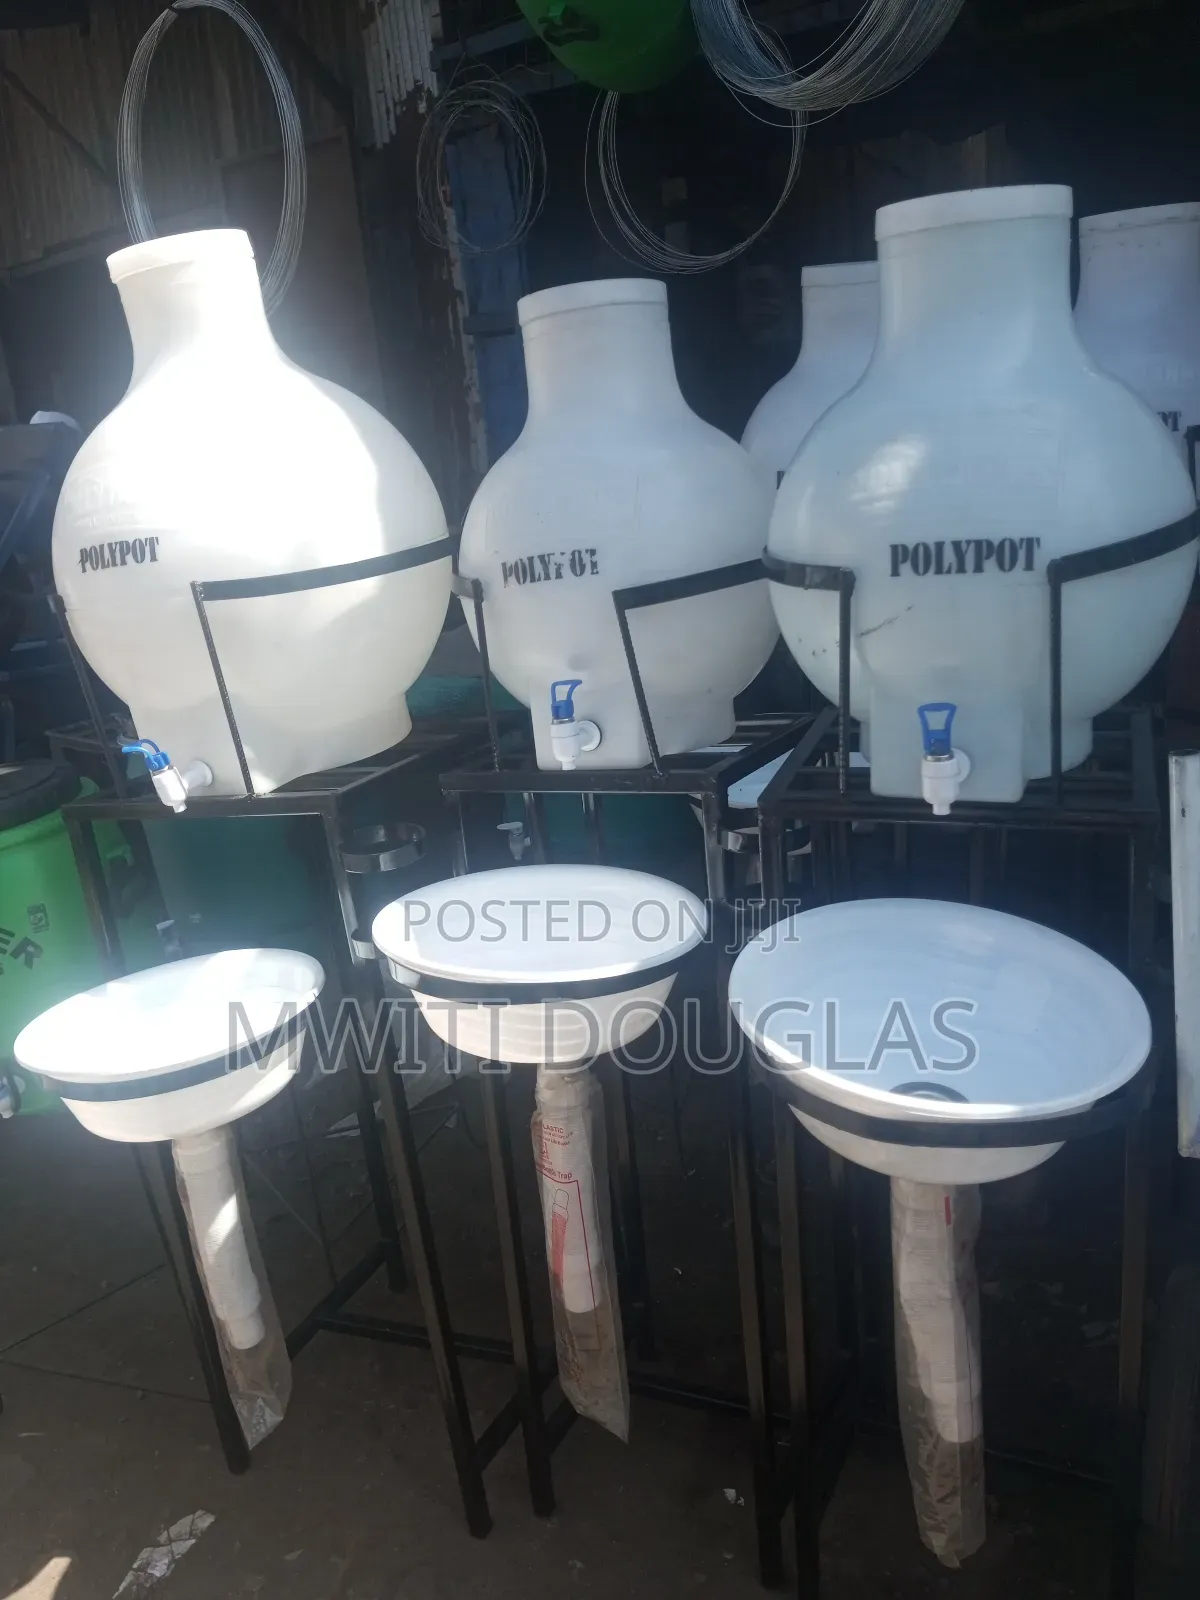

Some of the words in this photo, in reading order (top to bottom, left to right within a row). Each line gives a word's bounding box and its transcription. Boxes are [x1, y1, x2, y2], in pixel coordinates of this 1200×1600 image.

[78, 536, 160, 573] POLYPOT
[889, 536, 1041, 577] POLYPOT
[557, 1171, 573, 1180] Trap
